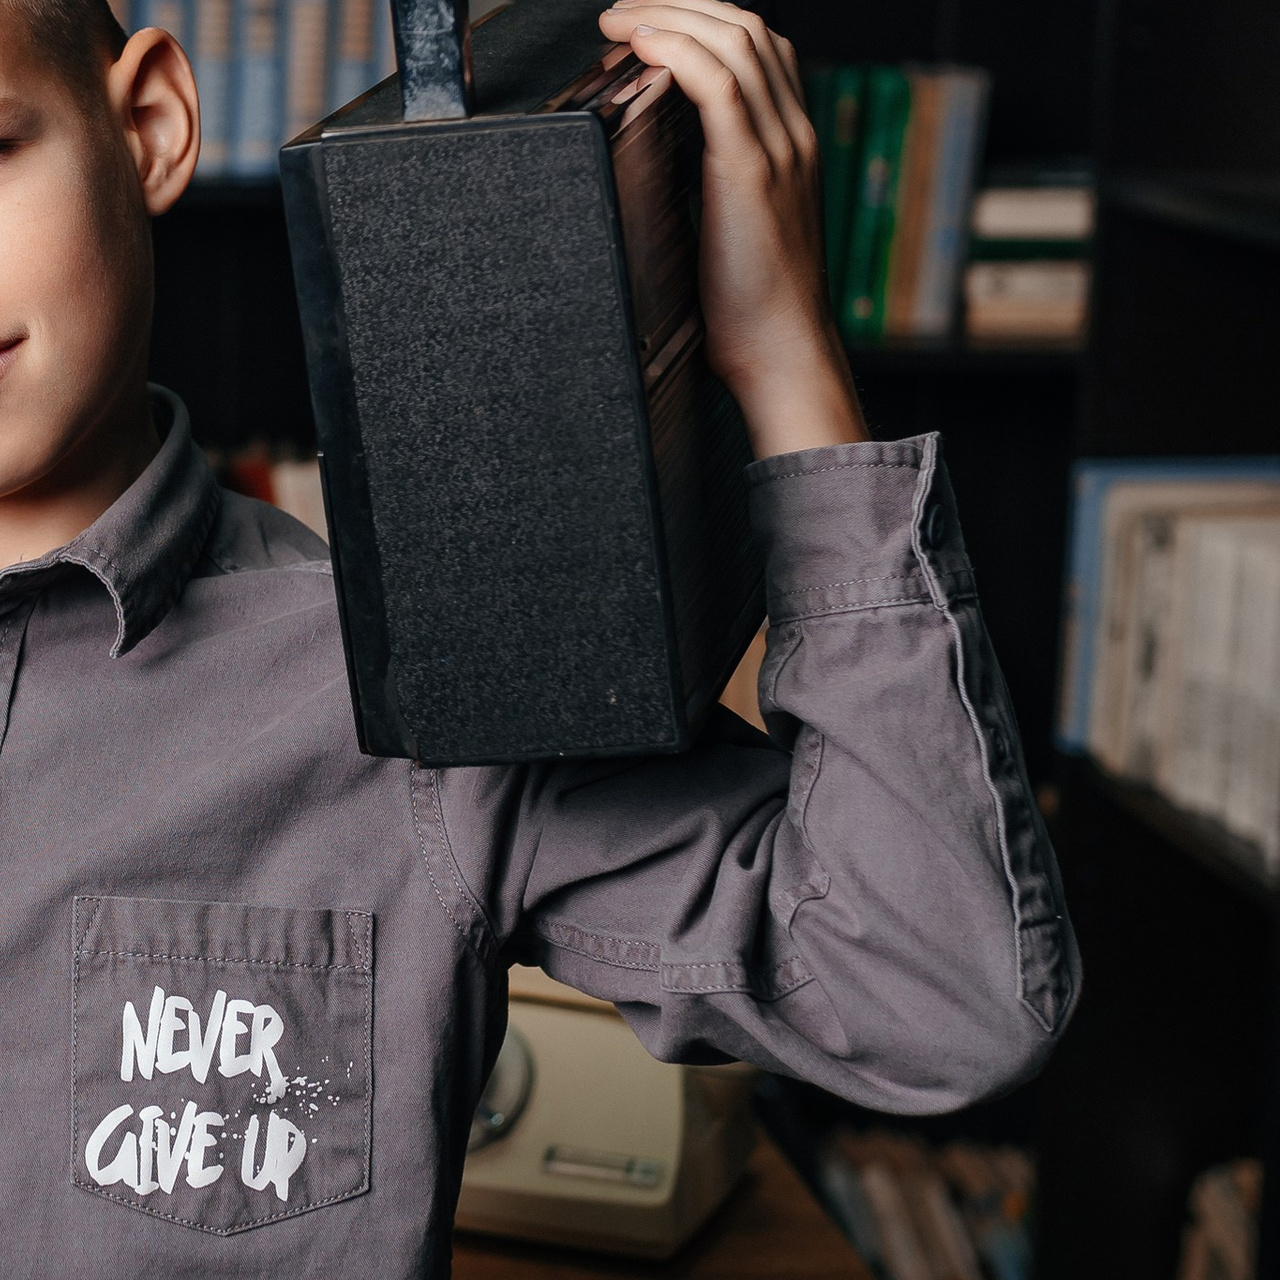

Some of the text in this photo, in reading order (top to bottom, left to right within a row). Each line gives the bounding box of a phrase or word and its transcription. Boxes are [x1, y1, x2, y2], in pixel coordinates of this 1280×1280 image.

[121, 985, 286, 1104] NEVER
[85, 1101, 307, 1202] GIVE UP
